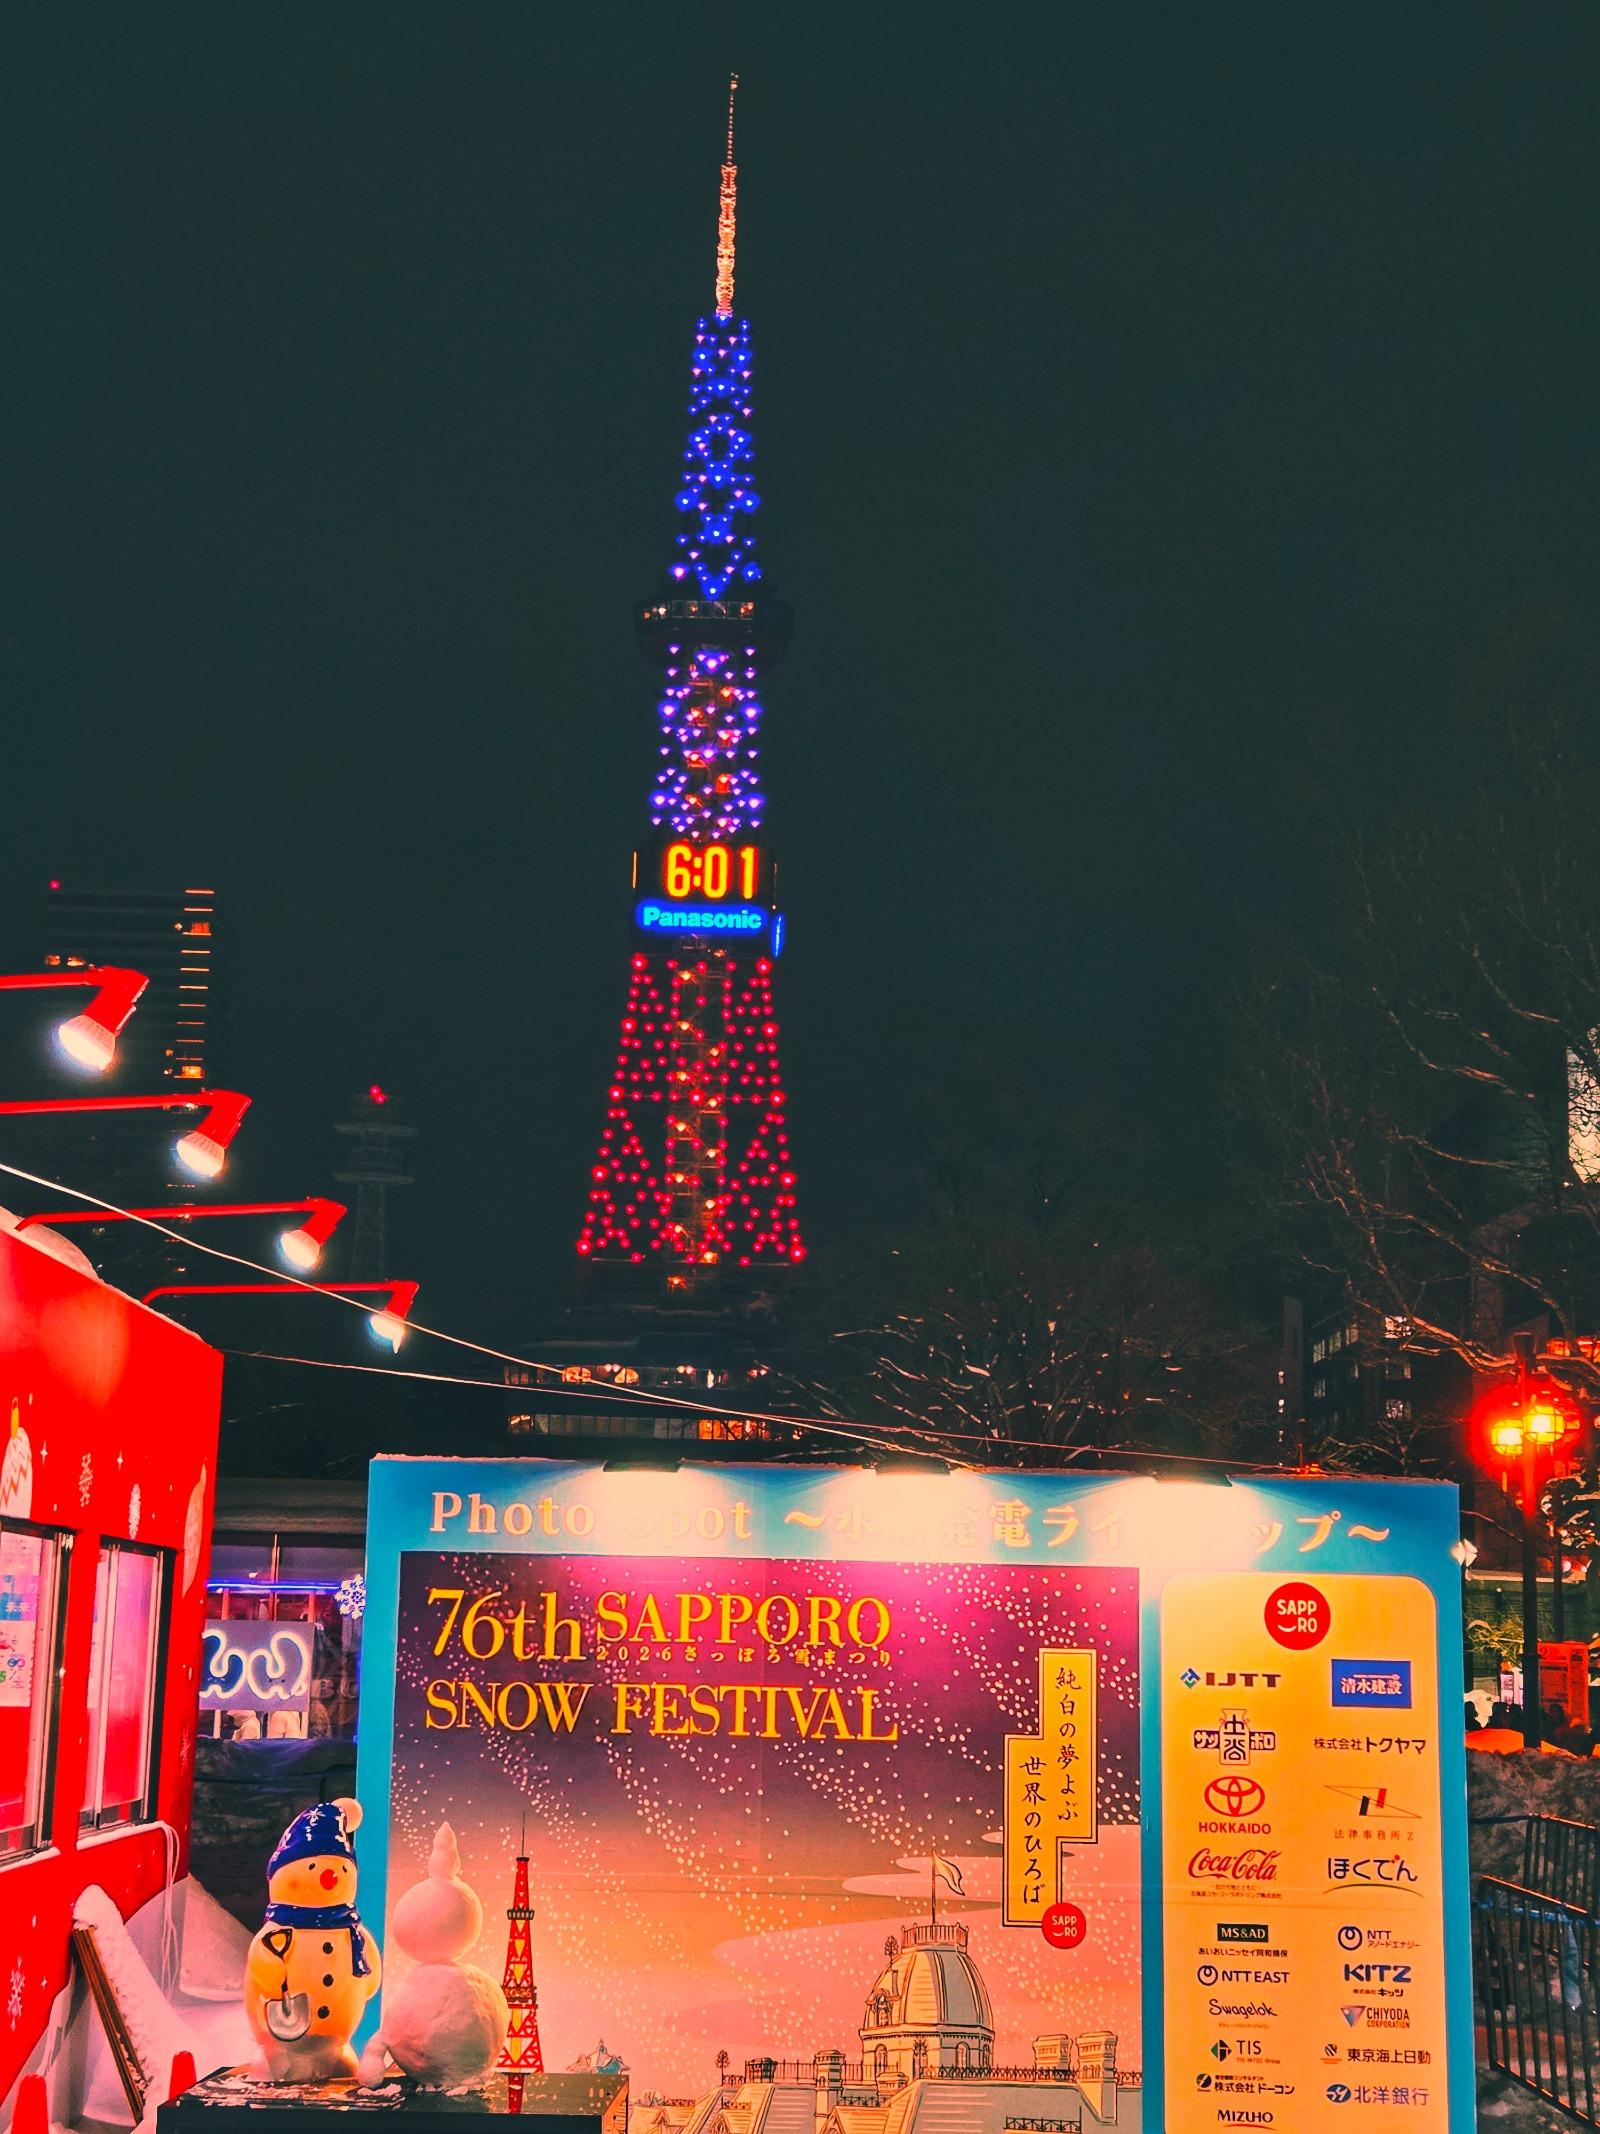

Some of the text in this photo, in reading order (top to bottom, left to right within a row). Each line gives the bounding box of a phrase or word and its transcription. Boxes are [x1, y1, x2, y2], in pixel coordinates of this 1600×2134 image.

[666, 845, 756, 899] 6:01
[643, 906, 762, 929] Panasonic
[429, 1490, 595, 1538] Photo
[427, 1588, 891, 1660] 76th SAPPORO
[1205, 1671, 1282, 1688] IJTT
[1341, 1677, 1402, 1695] 清水建設
[426, 1679, 899, 1741] SNOW FESTIVAL
[1054, 1667, 1083, 1822] 純白の夢よぶ
[1018, 1755, 1048, 1905] 世界のひろば
[1198, 1821, 1272, 1835] HOKKAIDO
[1187, 1847, 1283, 1881] Coca-Cola
[1327, 1854, 1419, 1882] ほくでん
[1220, 1926, 1266, 1939] MS&AD
[1366, 1930, 1392, 1940] NTT
[1221, 1970, 1291, 1984] NTT EAST
[1344, 1963, 1412, 1983] KITZ
[1208, 1998, 1278, 2020] Swagelok
[1366, 2007, 1410, 2021] CHIYODA
[1366, 2020, 1411, 2029] CORPORATION
[1235, 2039, 1262, 2055] TIS
[1347, 2047, 1431, 2065] 東京海上日動
[1353, 2085, 1430, 2106] 北洋銀行
[1216, 2109, 1274, 2123] MIZUHO
